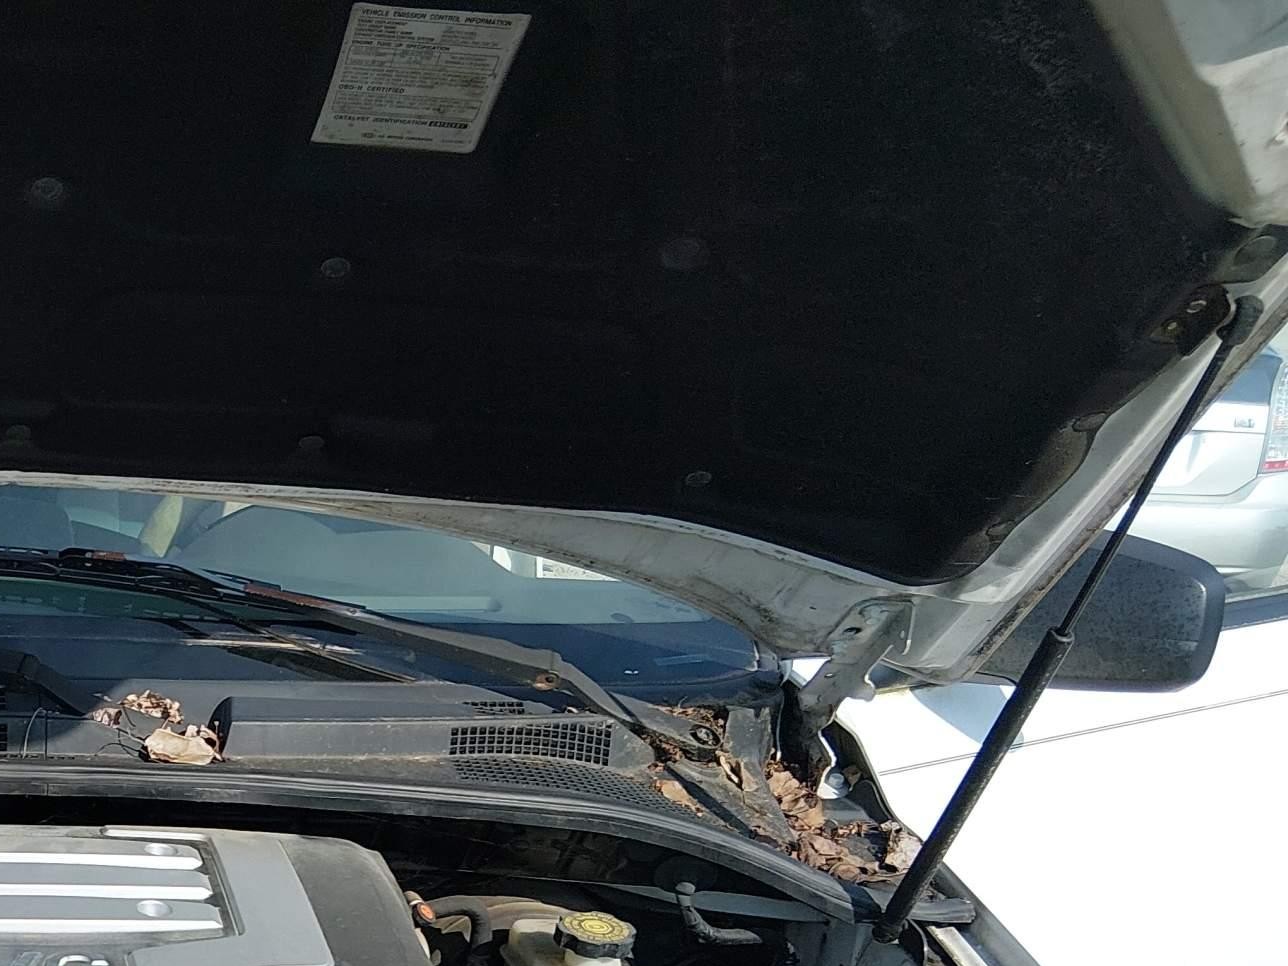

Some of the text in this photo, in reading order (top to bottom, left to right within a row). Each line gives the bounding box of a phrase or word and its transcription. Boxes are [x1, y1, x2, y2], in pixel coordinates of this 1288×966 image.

[361, 8, 513, 27] VEHICLE EMISSION CONTROL INFORMATION
[367, 85, 405, 94] CERTIFIED
